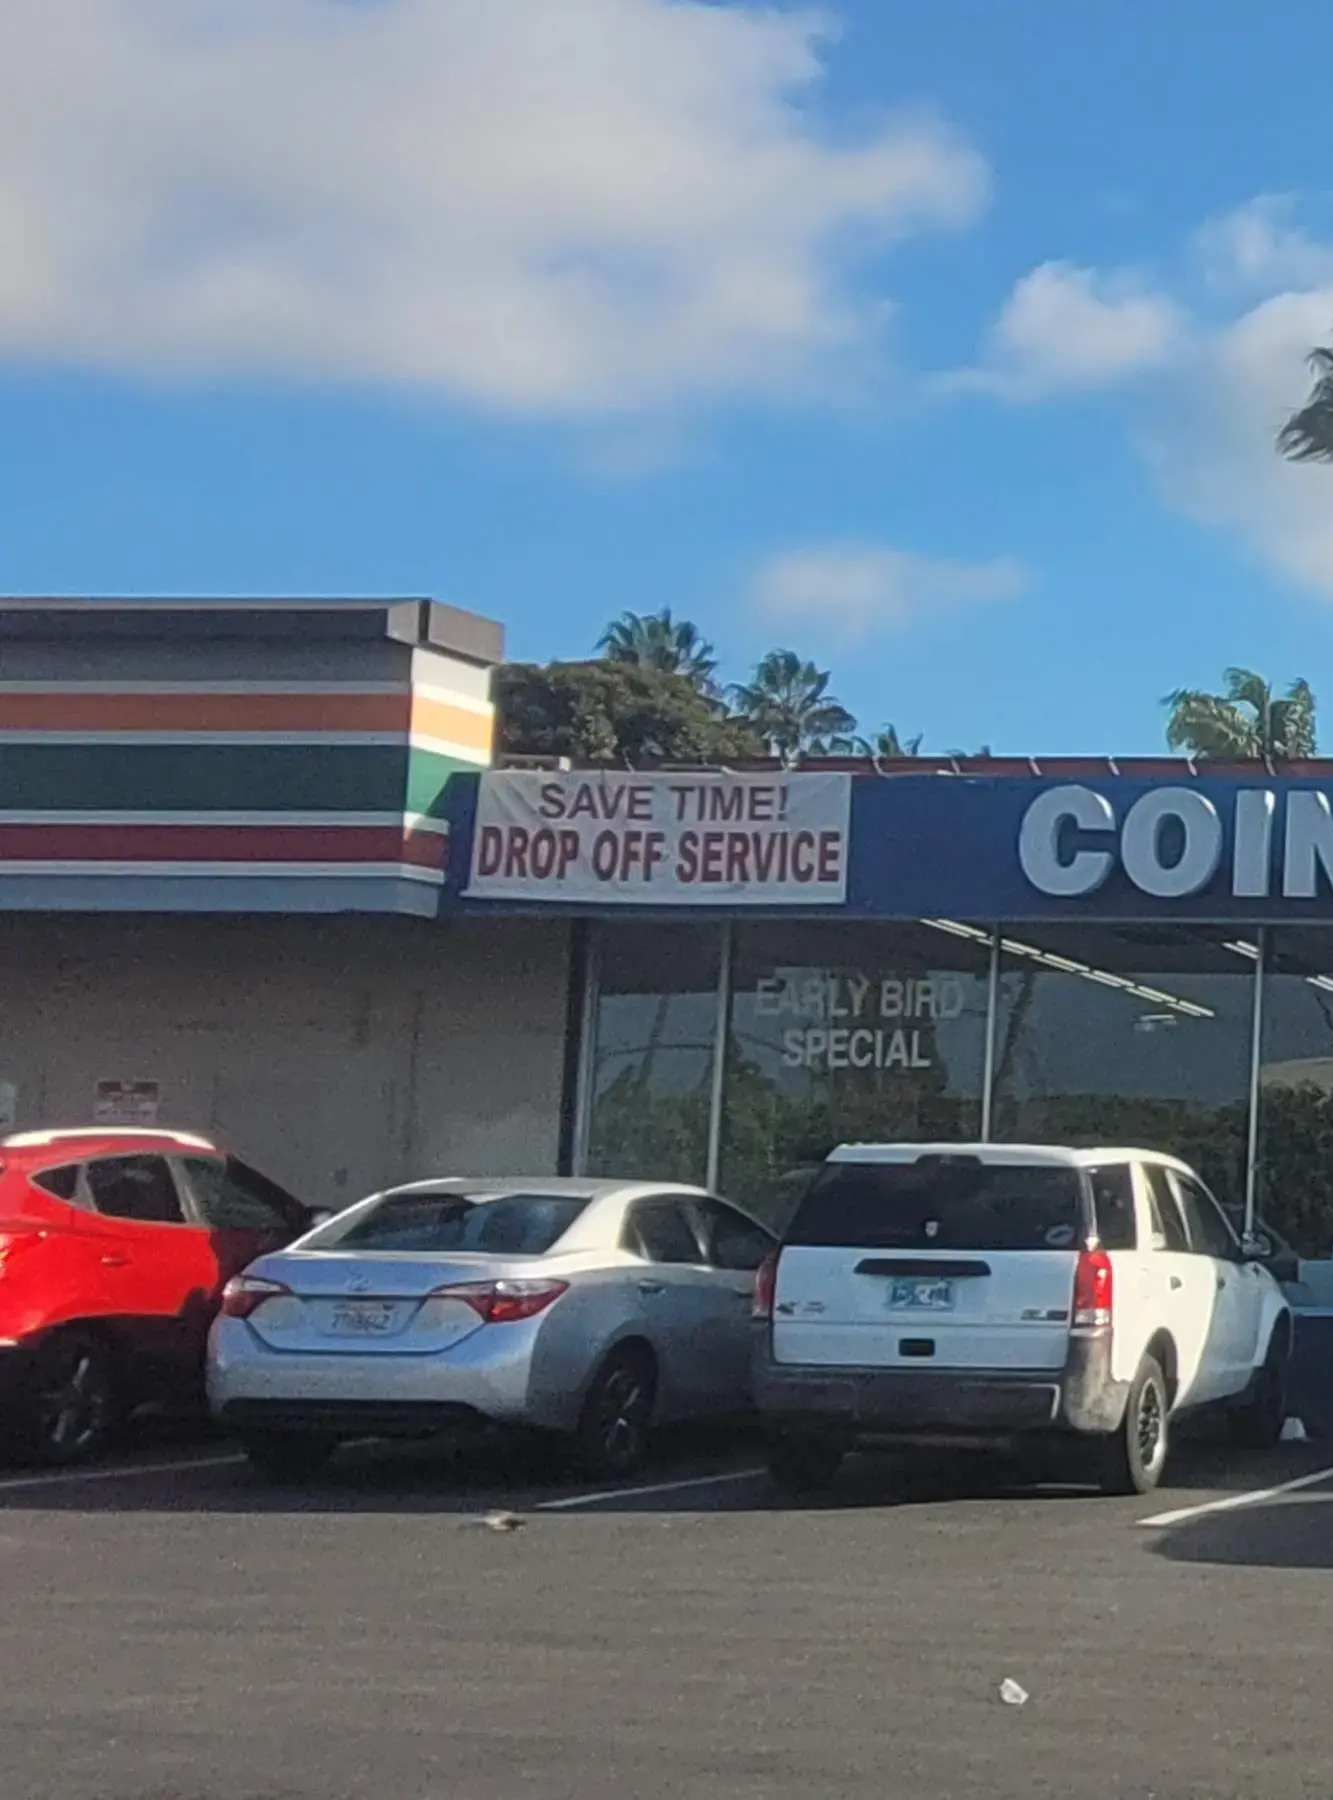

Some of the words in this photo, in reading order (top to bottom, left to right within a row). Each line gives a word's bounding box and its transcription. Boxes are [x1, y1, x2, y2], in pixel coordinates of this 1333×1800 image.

[538, 783, 655, 821] SAVE
[670, 786, 789, 822] TIME!
[477, 826, 581, 880] DROP
[591, 830, 666, 883] OFF
[676, 831, 841, 884] SERVICE
[756, 977, 870, 1018] EARLY
[880, 979, 966, 1018] BIRD
[783, 1028, 931, 1068] SPECIAL
